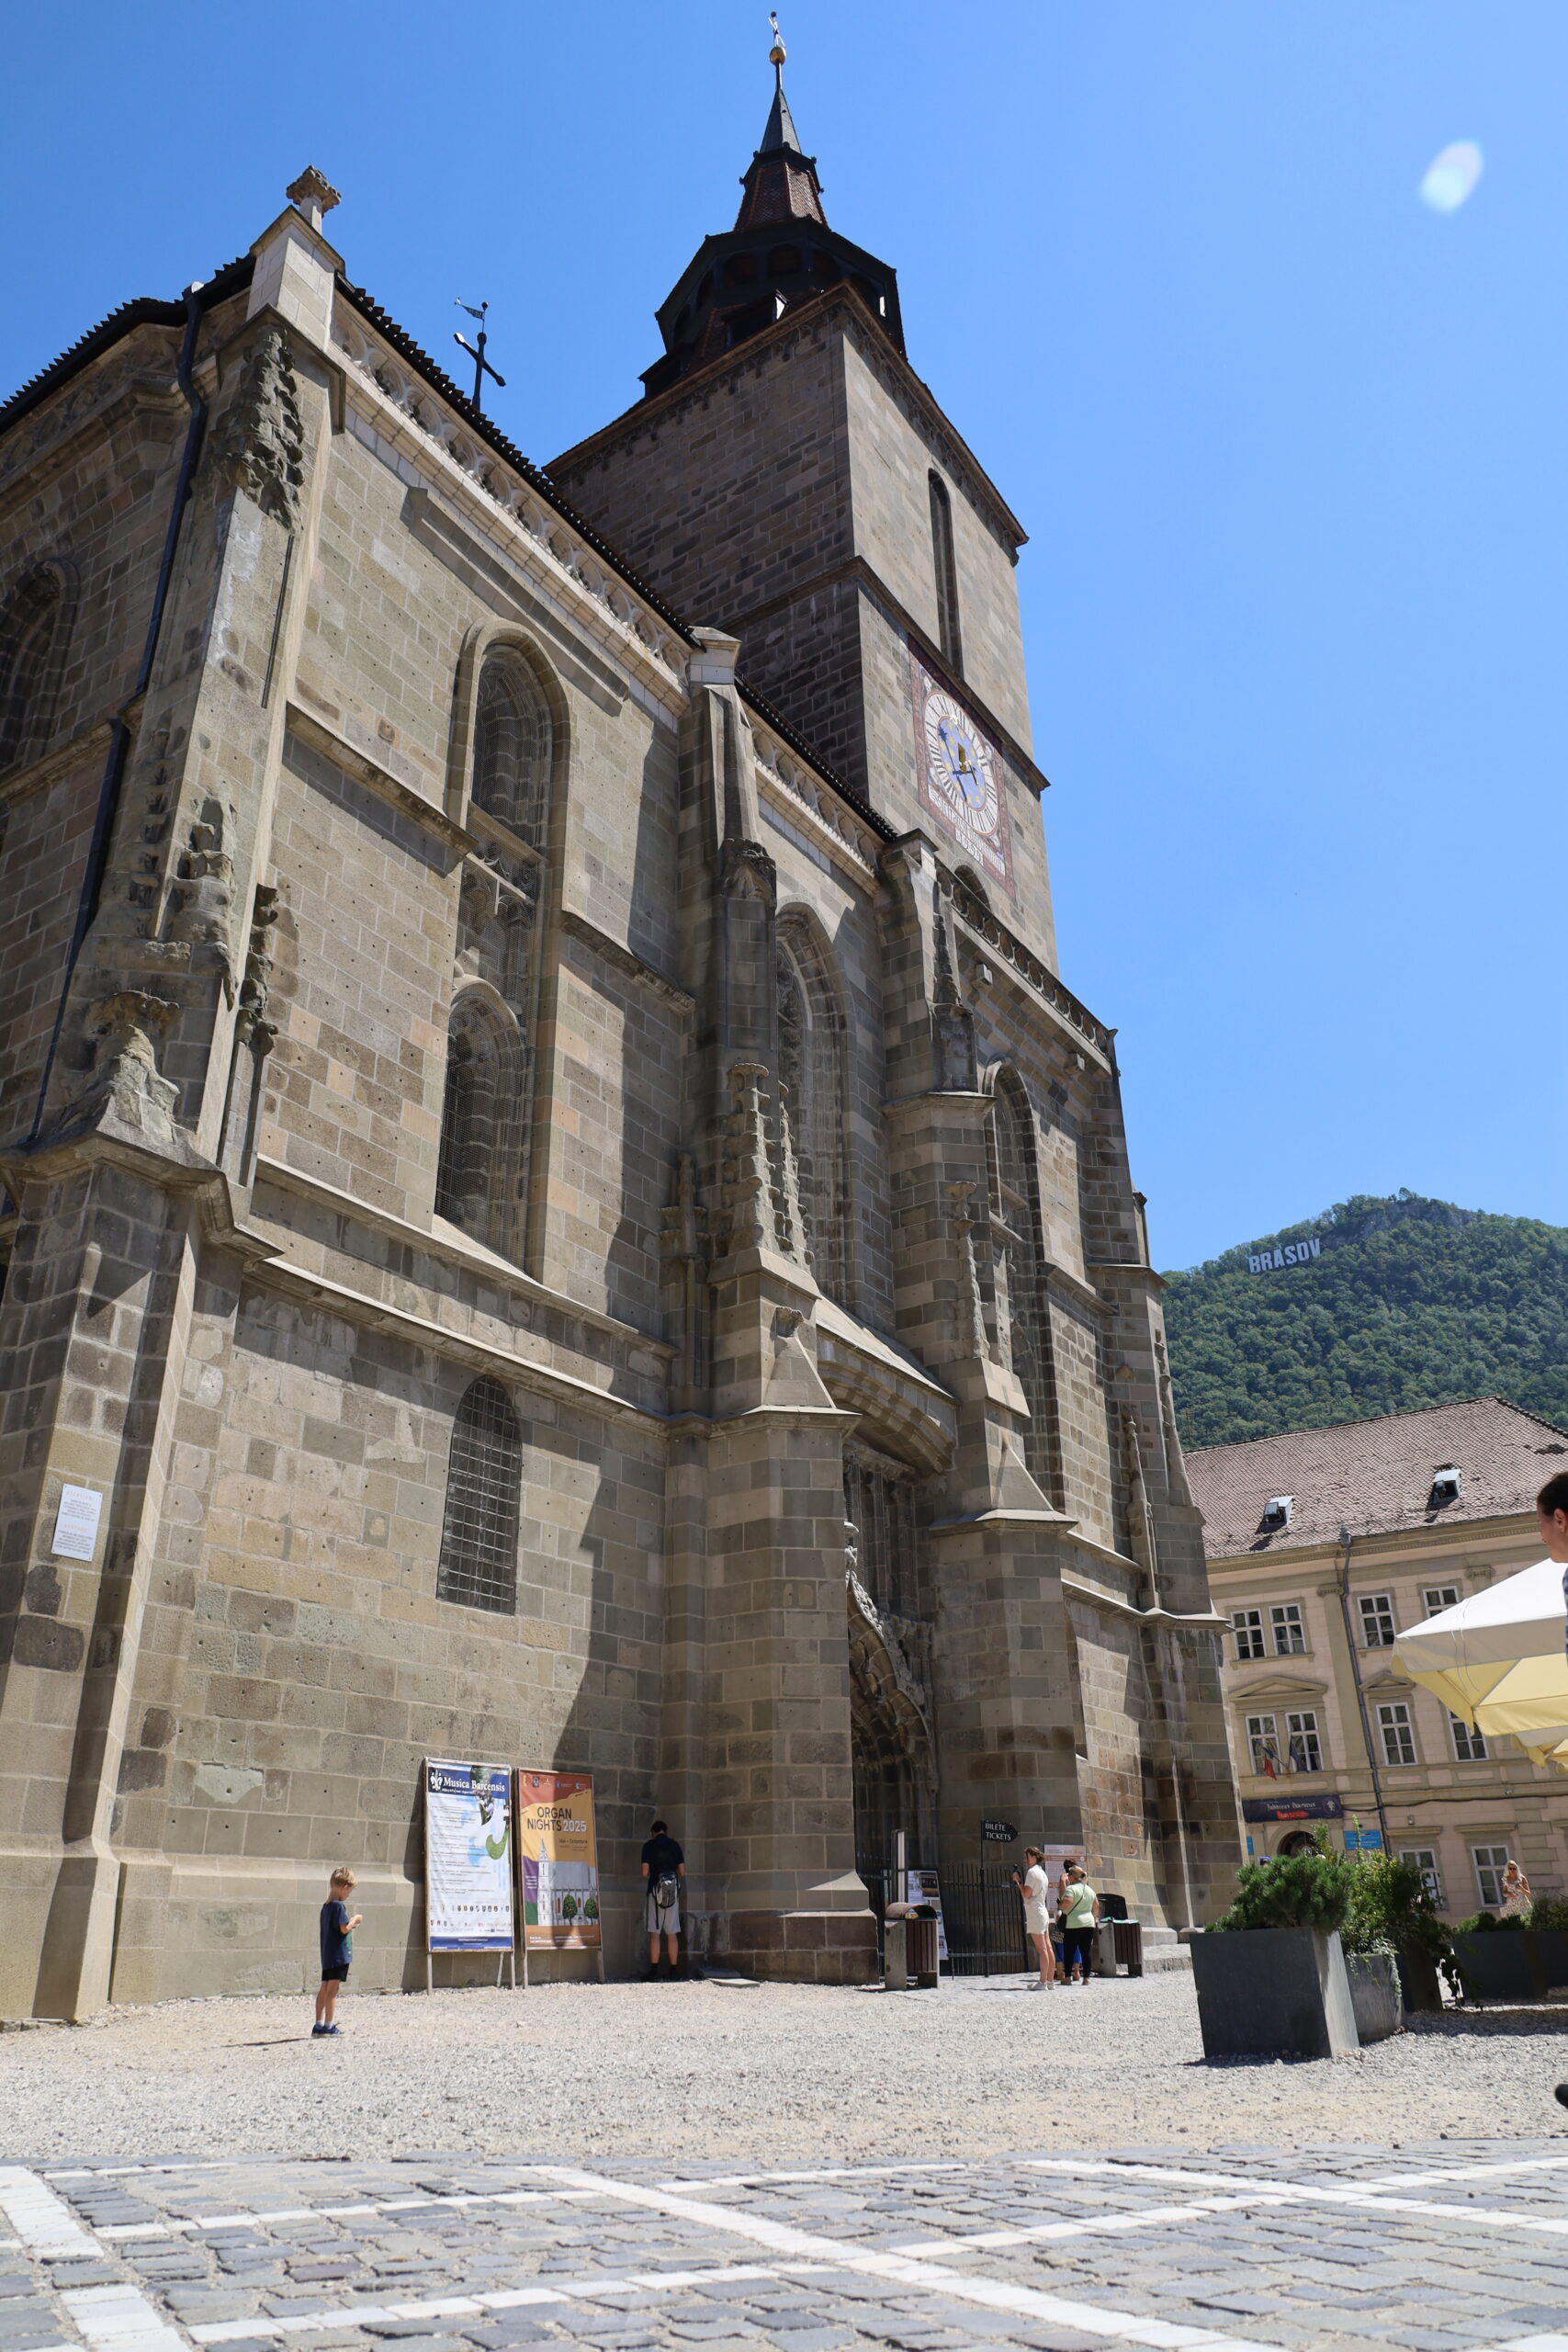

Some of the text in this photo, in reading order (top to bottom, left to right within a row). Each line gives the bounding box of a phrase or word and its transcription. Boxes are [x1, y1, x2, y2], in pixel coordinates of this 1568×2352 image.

[1248, 1238, 1321, 1273] BRASOV
[443, 1776, 469, 1789] Musica
[471, 1780, 505, 1792] Barcensis
[536, 1806, 572, 1820] ORGAN
[526, 1818, 587, 1832] NIGHTS 2025
[985, 1822, 1006, 1831] BILETE
[986, 1831, 1011, 1841] TICKETS
